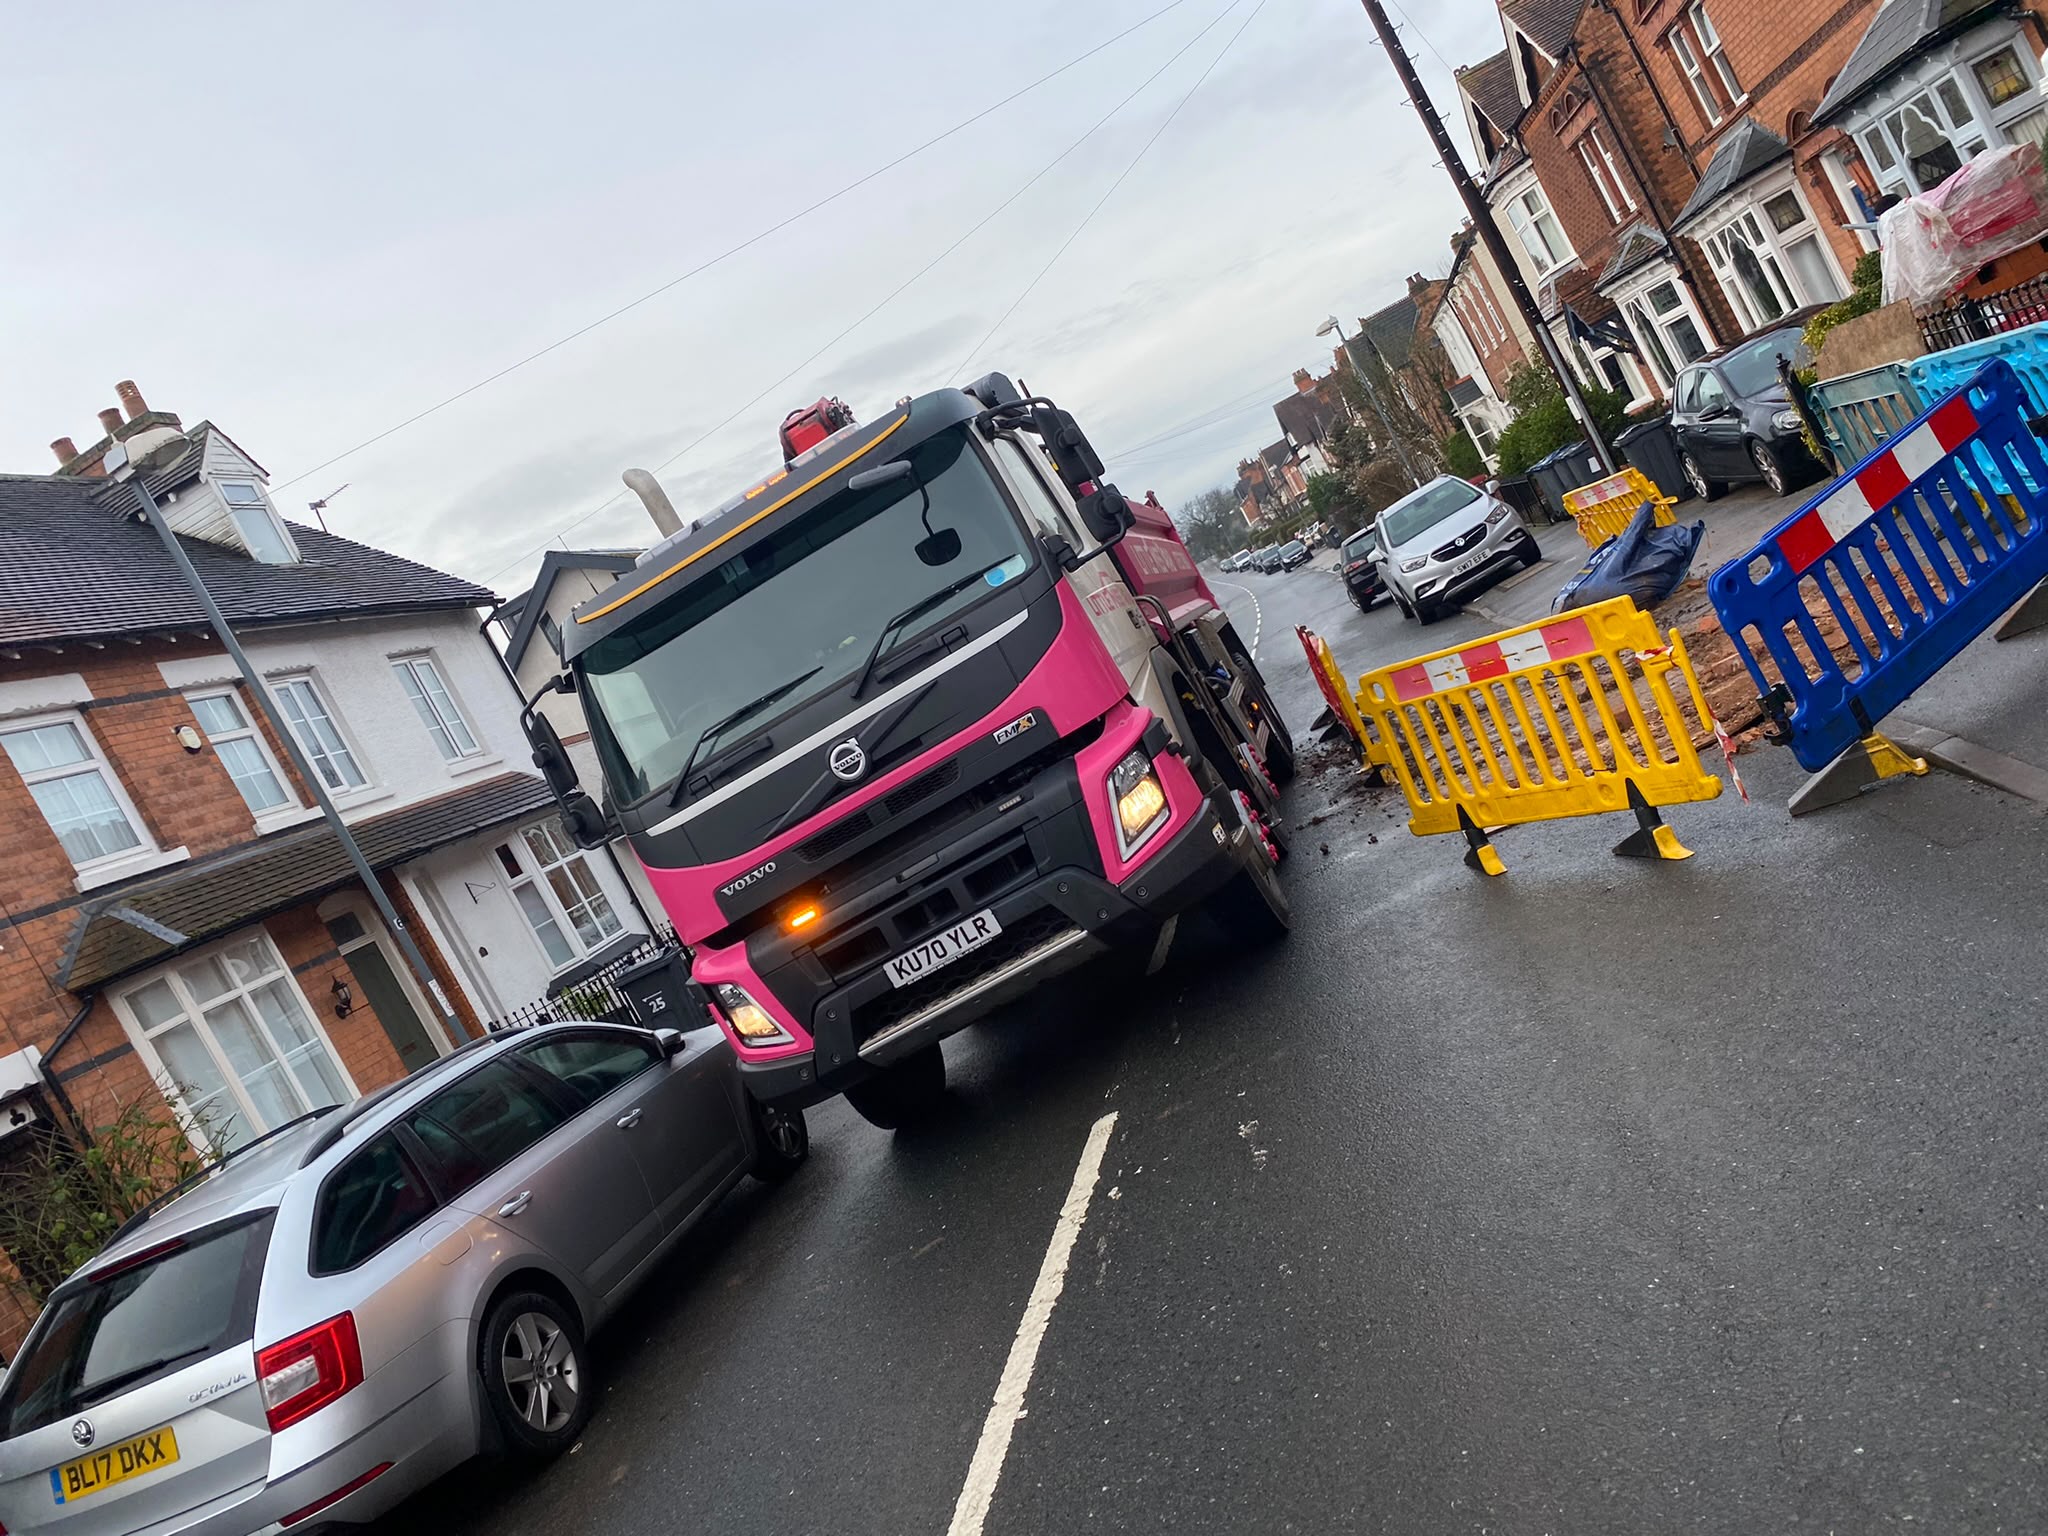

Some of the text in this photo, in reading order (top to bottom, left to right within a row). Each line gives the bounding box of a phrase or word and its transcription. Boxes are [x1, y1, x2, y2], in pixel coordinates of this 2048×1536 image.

[1473, 551, 1488, 563] EFE
[997, 715, 1034, 742] FMX
[833, 752, 863, 771] VOLVO
[721, 862, 777, 896] VOLVO
[892, 938, 948, 980] KU70
[946, 916, 991, 949] YLR
[648, 996, 666, 1013] 25
[65, 1434, 166, 1494] BL17 DKX
